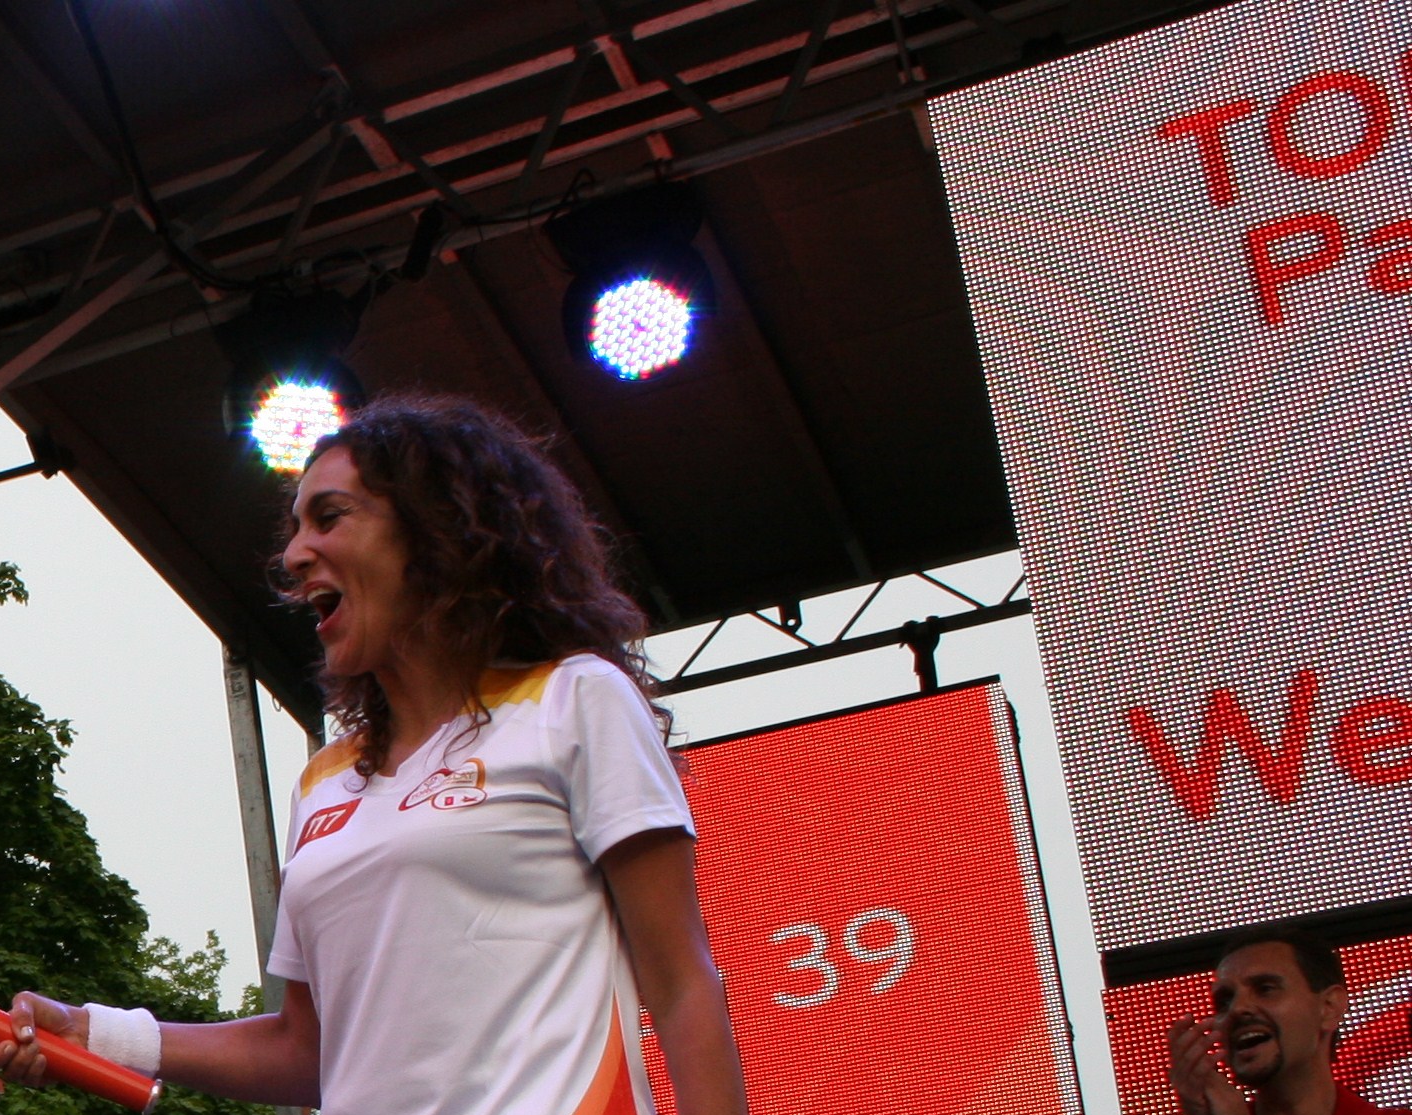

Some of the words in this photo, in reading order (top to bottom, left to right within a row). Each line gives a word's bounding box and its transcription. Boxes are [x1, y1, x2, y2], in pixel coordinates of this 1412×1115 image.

[1155, 48, 1412, 208] TO
[1128, 669, 1412, 822] We
[769, 907, 915, 1010] 39
